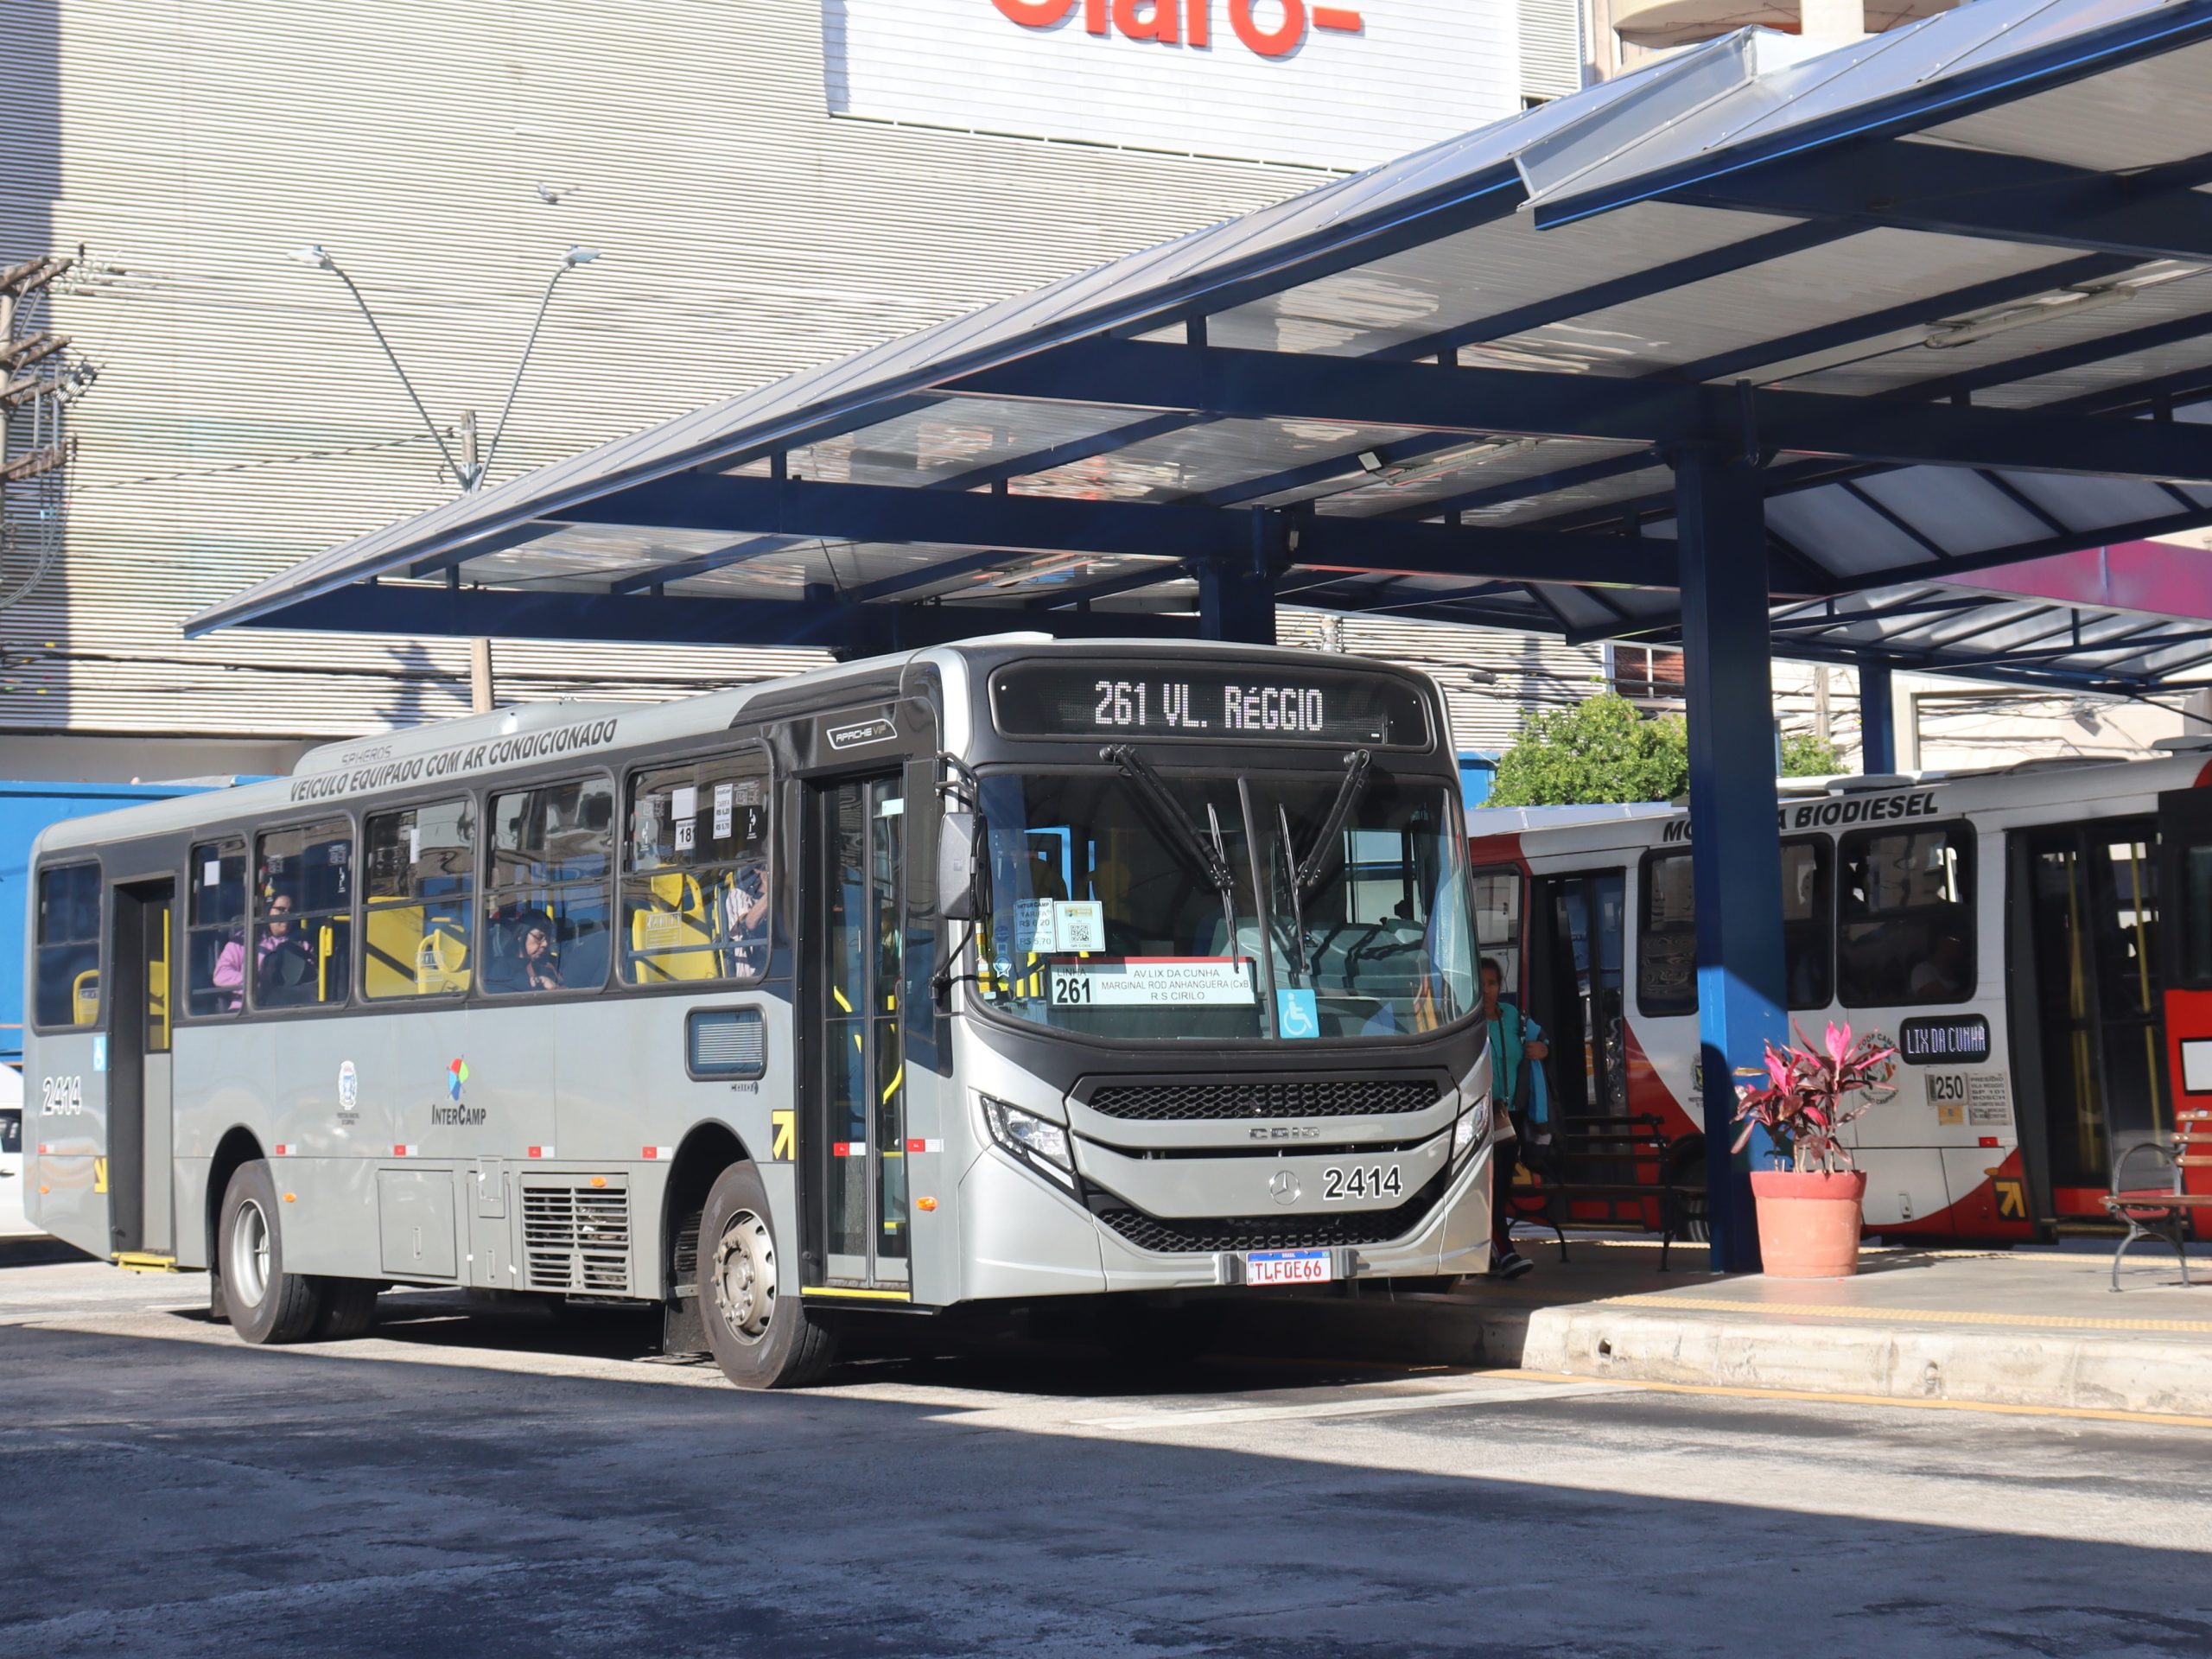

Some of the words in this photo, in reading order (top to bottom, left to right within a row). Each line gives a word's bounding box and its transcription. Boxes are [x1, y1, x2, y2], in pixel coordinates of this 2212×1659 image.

[1096, 681, 1146, 725] 261
[1163, 683, 1207, 728] VL.
[836, 728, 872, 742] APACHE
[873, 724, 887, 735] VIP
[341, 745, 392, 766] SPHEROS
[349, 757, 425, 792] EQUIPADO
[425, 749, 464, 778] COM
[462, 745, 487, 772] AR
[488, 718, 618, 766] CONDICIONADO
[1795, 792, 1938, 829] BIODIESEL
[1057, 967, 1086, 977] LINHA
[1166, 969, 1183, 977] DA
[1184, 969, 1220, 977] CUNHA
[1056, 977, 1090, 1003] 261
[1101, 981, 1147, 990] MARGINAL
[1171, 991, 1205, 1001] CIRILO
[1906, 1028, 1929, 1054] LIX
[1931, 1027, 1947, 1053] DA
[1948, 1026, 1986, 1052] CUNHA
[43, 1075, 82, 1116] 2414
[1936, 1075, 1964, 1100] 250
[1323, 1165, 1403, 1200] 2414
